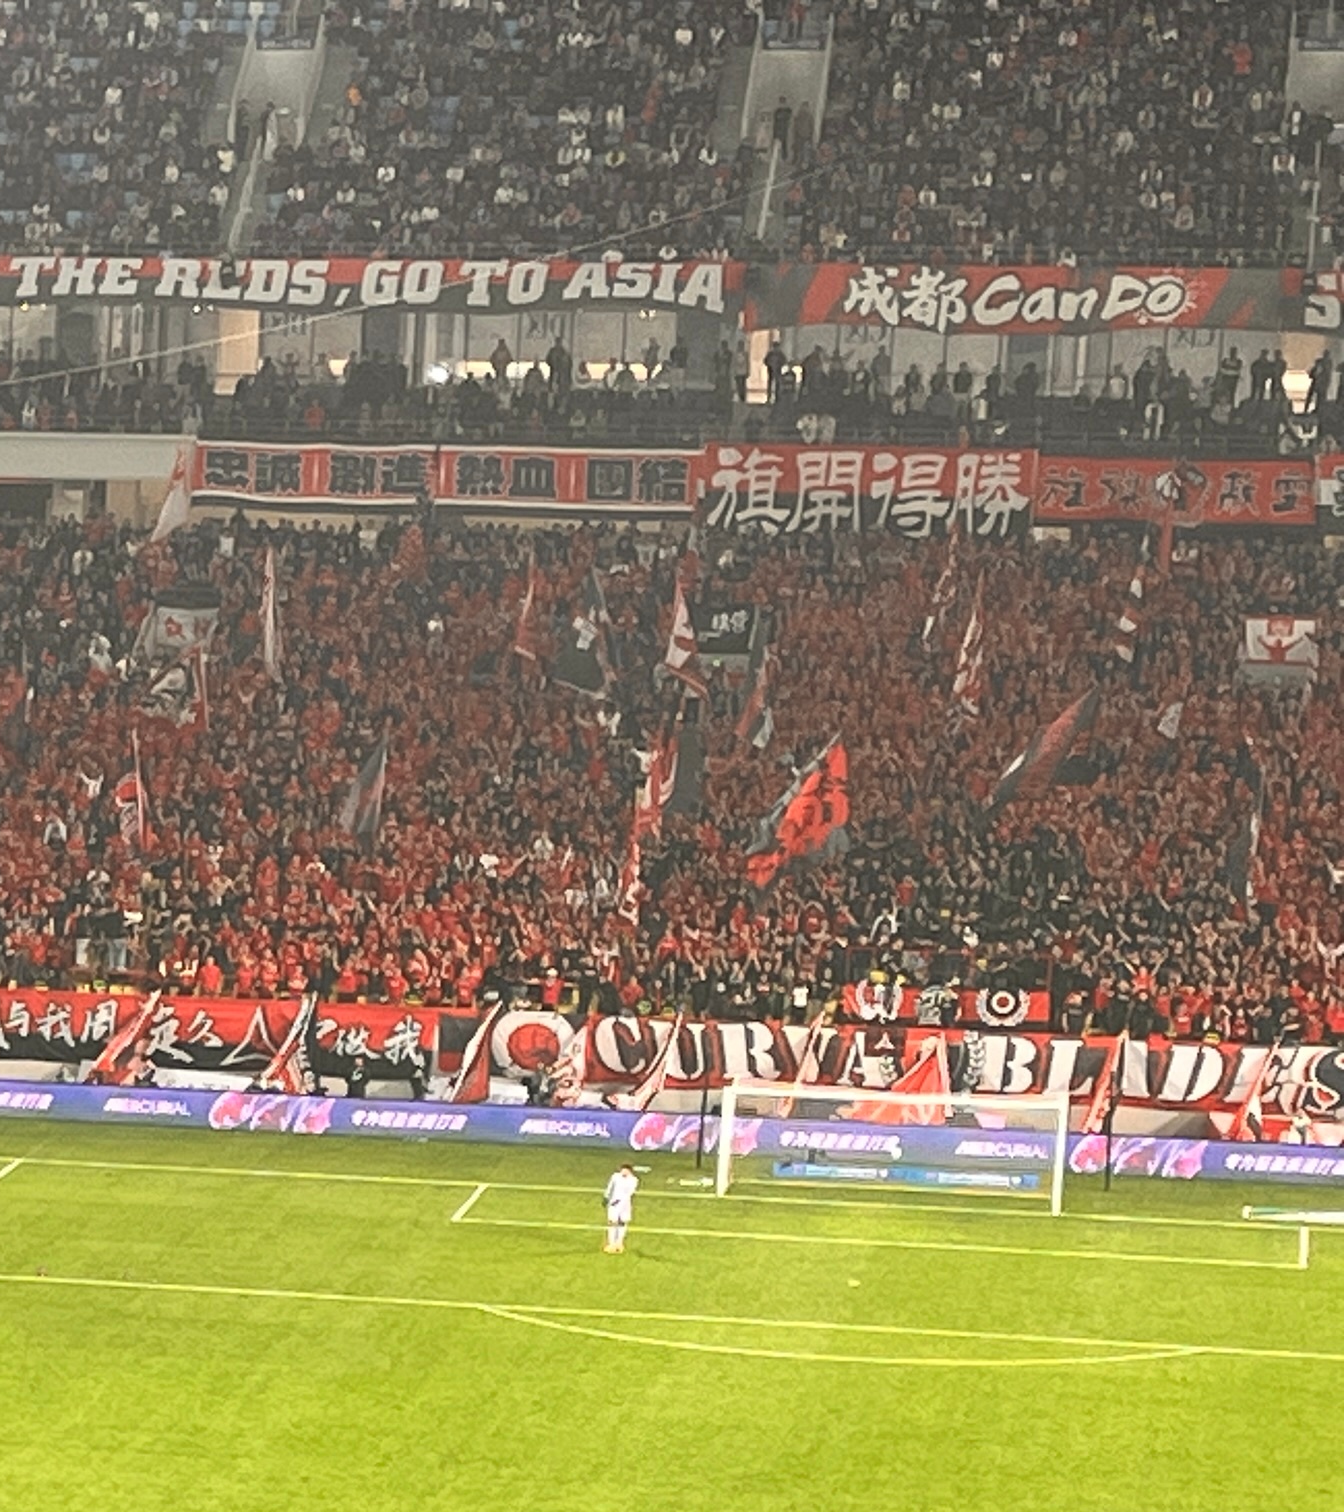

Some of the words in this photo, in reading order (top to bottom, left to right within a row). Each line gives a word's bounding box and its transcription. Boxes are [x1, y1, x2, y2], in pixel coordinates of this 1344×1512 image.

[14, 256, 144, 298] THE
[361, 260, 442, 304] GO
[459, 260, 549, 307] TO
[563, 262, 724, 311] ASIA
[707, 447, 1031, 538] 旗開得勝
[596, 1014, 900, 1089] CURVA
